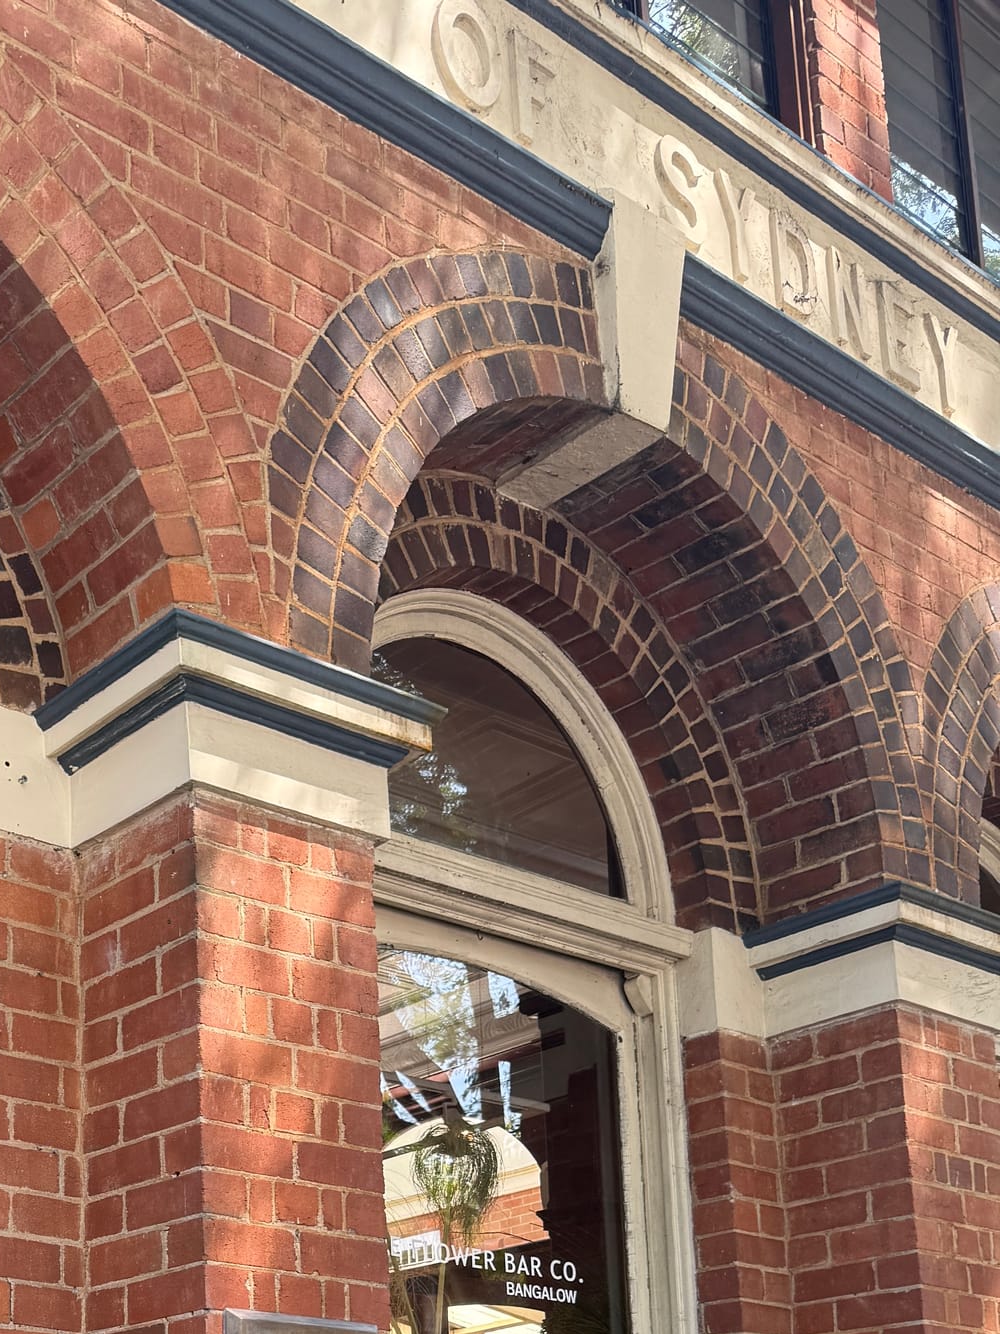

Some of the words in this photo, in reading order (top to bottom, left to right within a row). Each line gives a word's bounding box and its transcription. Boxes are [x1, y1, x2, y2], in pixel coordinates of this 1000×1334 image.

[430, 0, 560, 146] OF
[653, 134, 959, 417] SYDNEY
[411, 1239, 497, 1272] FLOWER
[504, 1252, 543, 1278] BAR
[550, 1259, 584, 1284] CO.
[505, 1281, 577, 1304] BANGALOW
